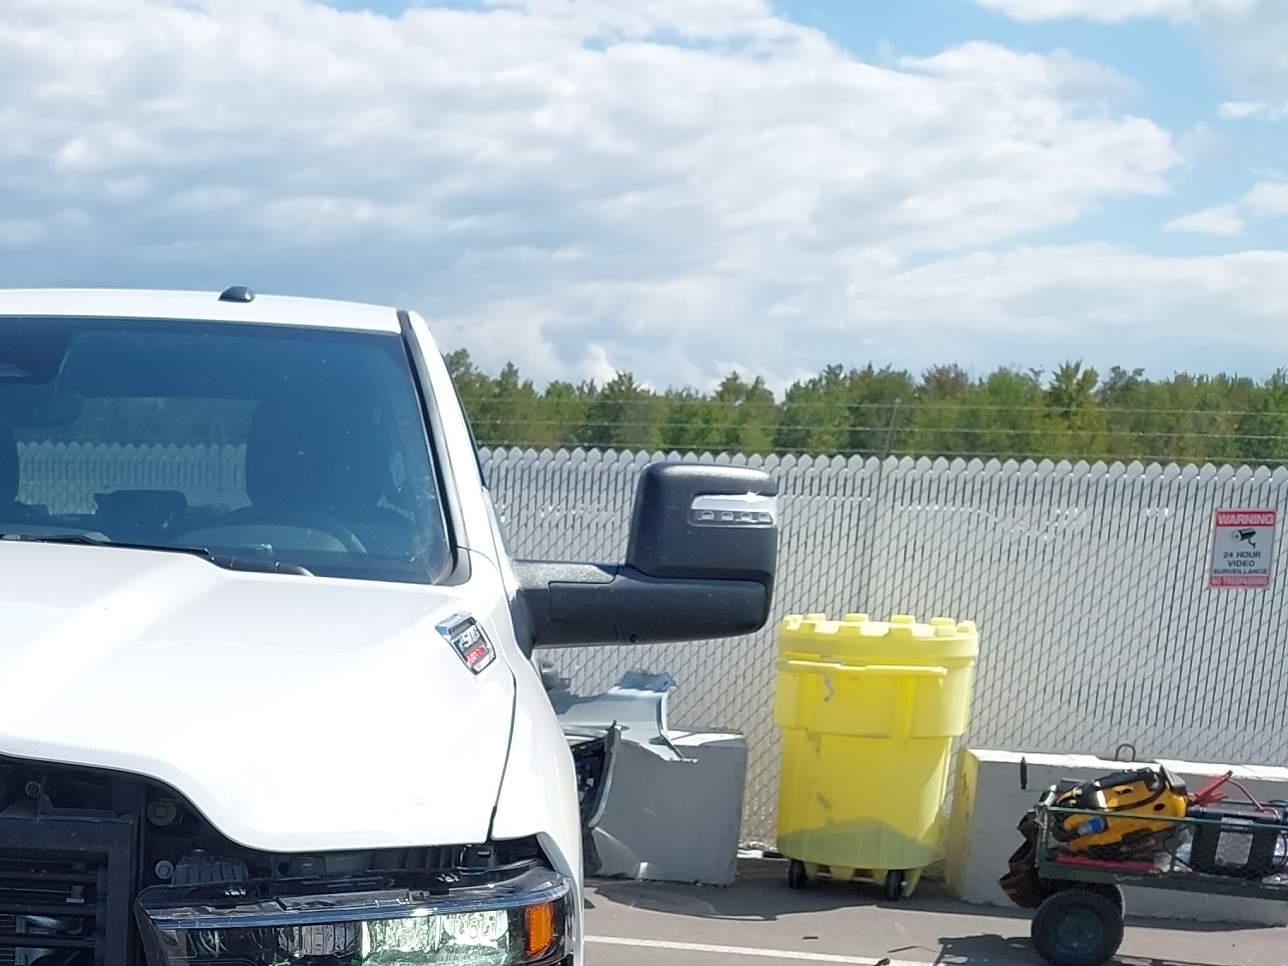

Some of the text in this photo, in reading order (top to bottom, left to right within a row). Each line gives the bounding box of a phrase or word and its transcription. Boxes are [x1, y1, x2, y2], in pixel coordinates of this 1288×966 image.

[1217, 513, 1274, 525] WARNING
[1223, 551, 1261, 559] 24 HOUR
[1227, 560, 1255, 568] VIDEO
